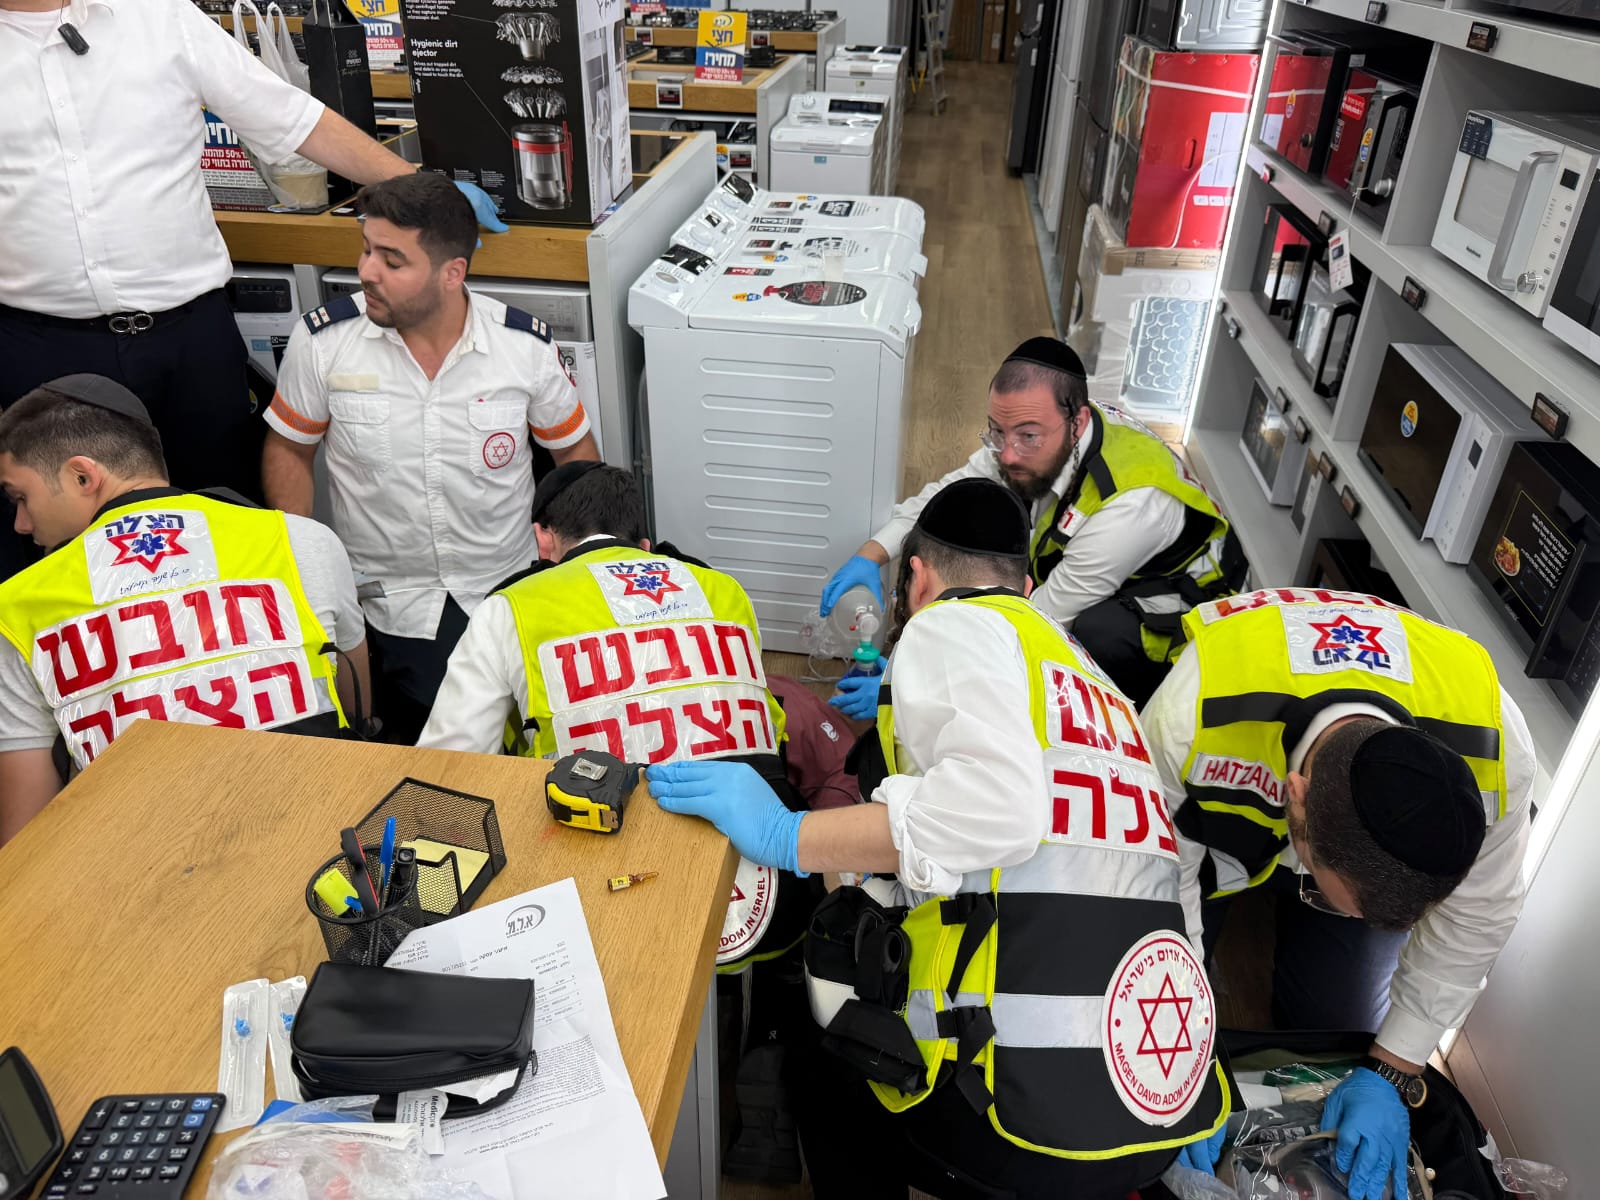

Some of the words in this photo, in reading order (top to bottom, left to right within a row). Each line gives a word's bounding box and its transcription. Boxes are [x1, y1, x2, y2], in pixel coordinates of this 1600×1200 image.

[410, 38, 443, 49] Hygienic
[444, 39, 458, 48] dirt
[412, 49, 437, 58] ejector
[225, 149, 241, 158] 50%
[231, 160, 254, 169] חזרה
[105, 514, 184, 537] הצלה
[605, 562, 670, 574] הצלה
[37, 584, 287, 698] חובש
[554, 624, 758, 703] חובש
[718, 927, 746, 947] DOM
[745, 916, 756, 930] IN
[752, 877, 766, 917] ISRAEL
[1157, 948, 1180, 963] אדום
[1181, 955, 1194, 976] דוד
[1119, 955, 1155, 1002] בישראל
[1114, 1042, 1138, 1089] MAGEN
[1137, 1084, 1162, 1106] DAVID
[1162, 1087, 1183, 1106] ADOM
[1181, 1079, 1190, 1092] IN
[1189, 1037, 1208, 1081] ISRAEL
